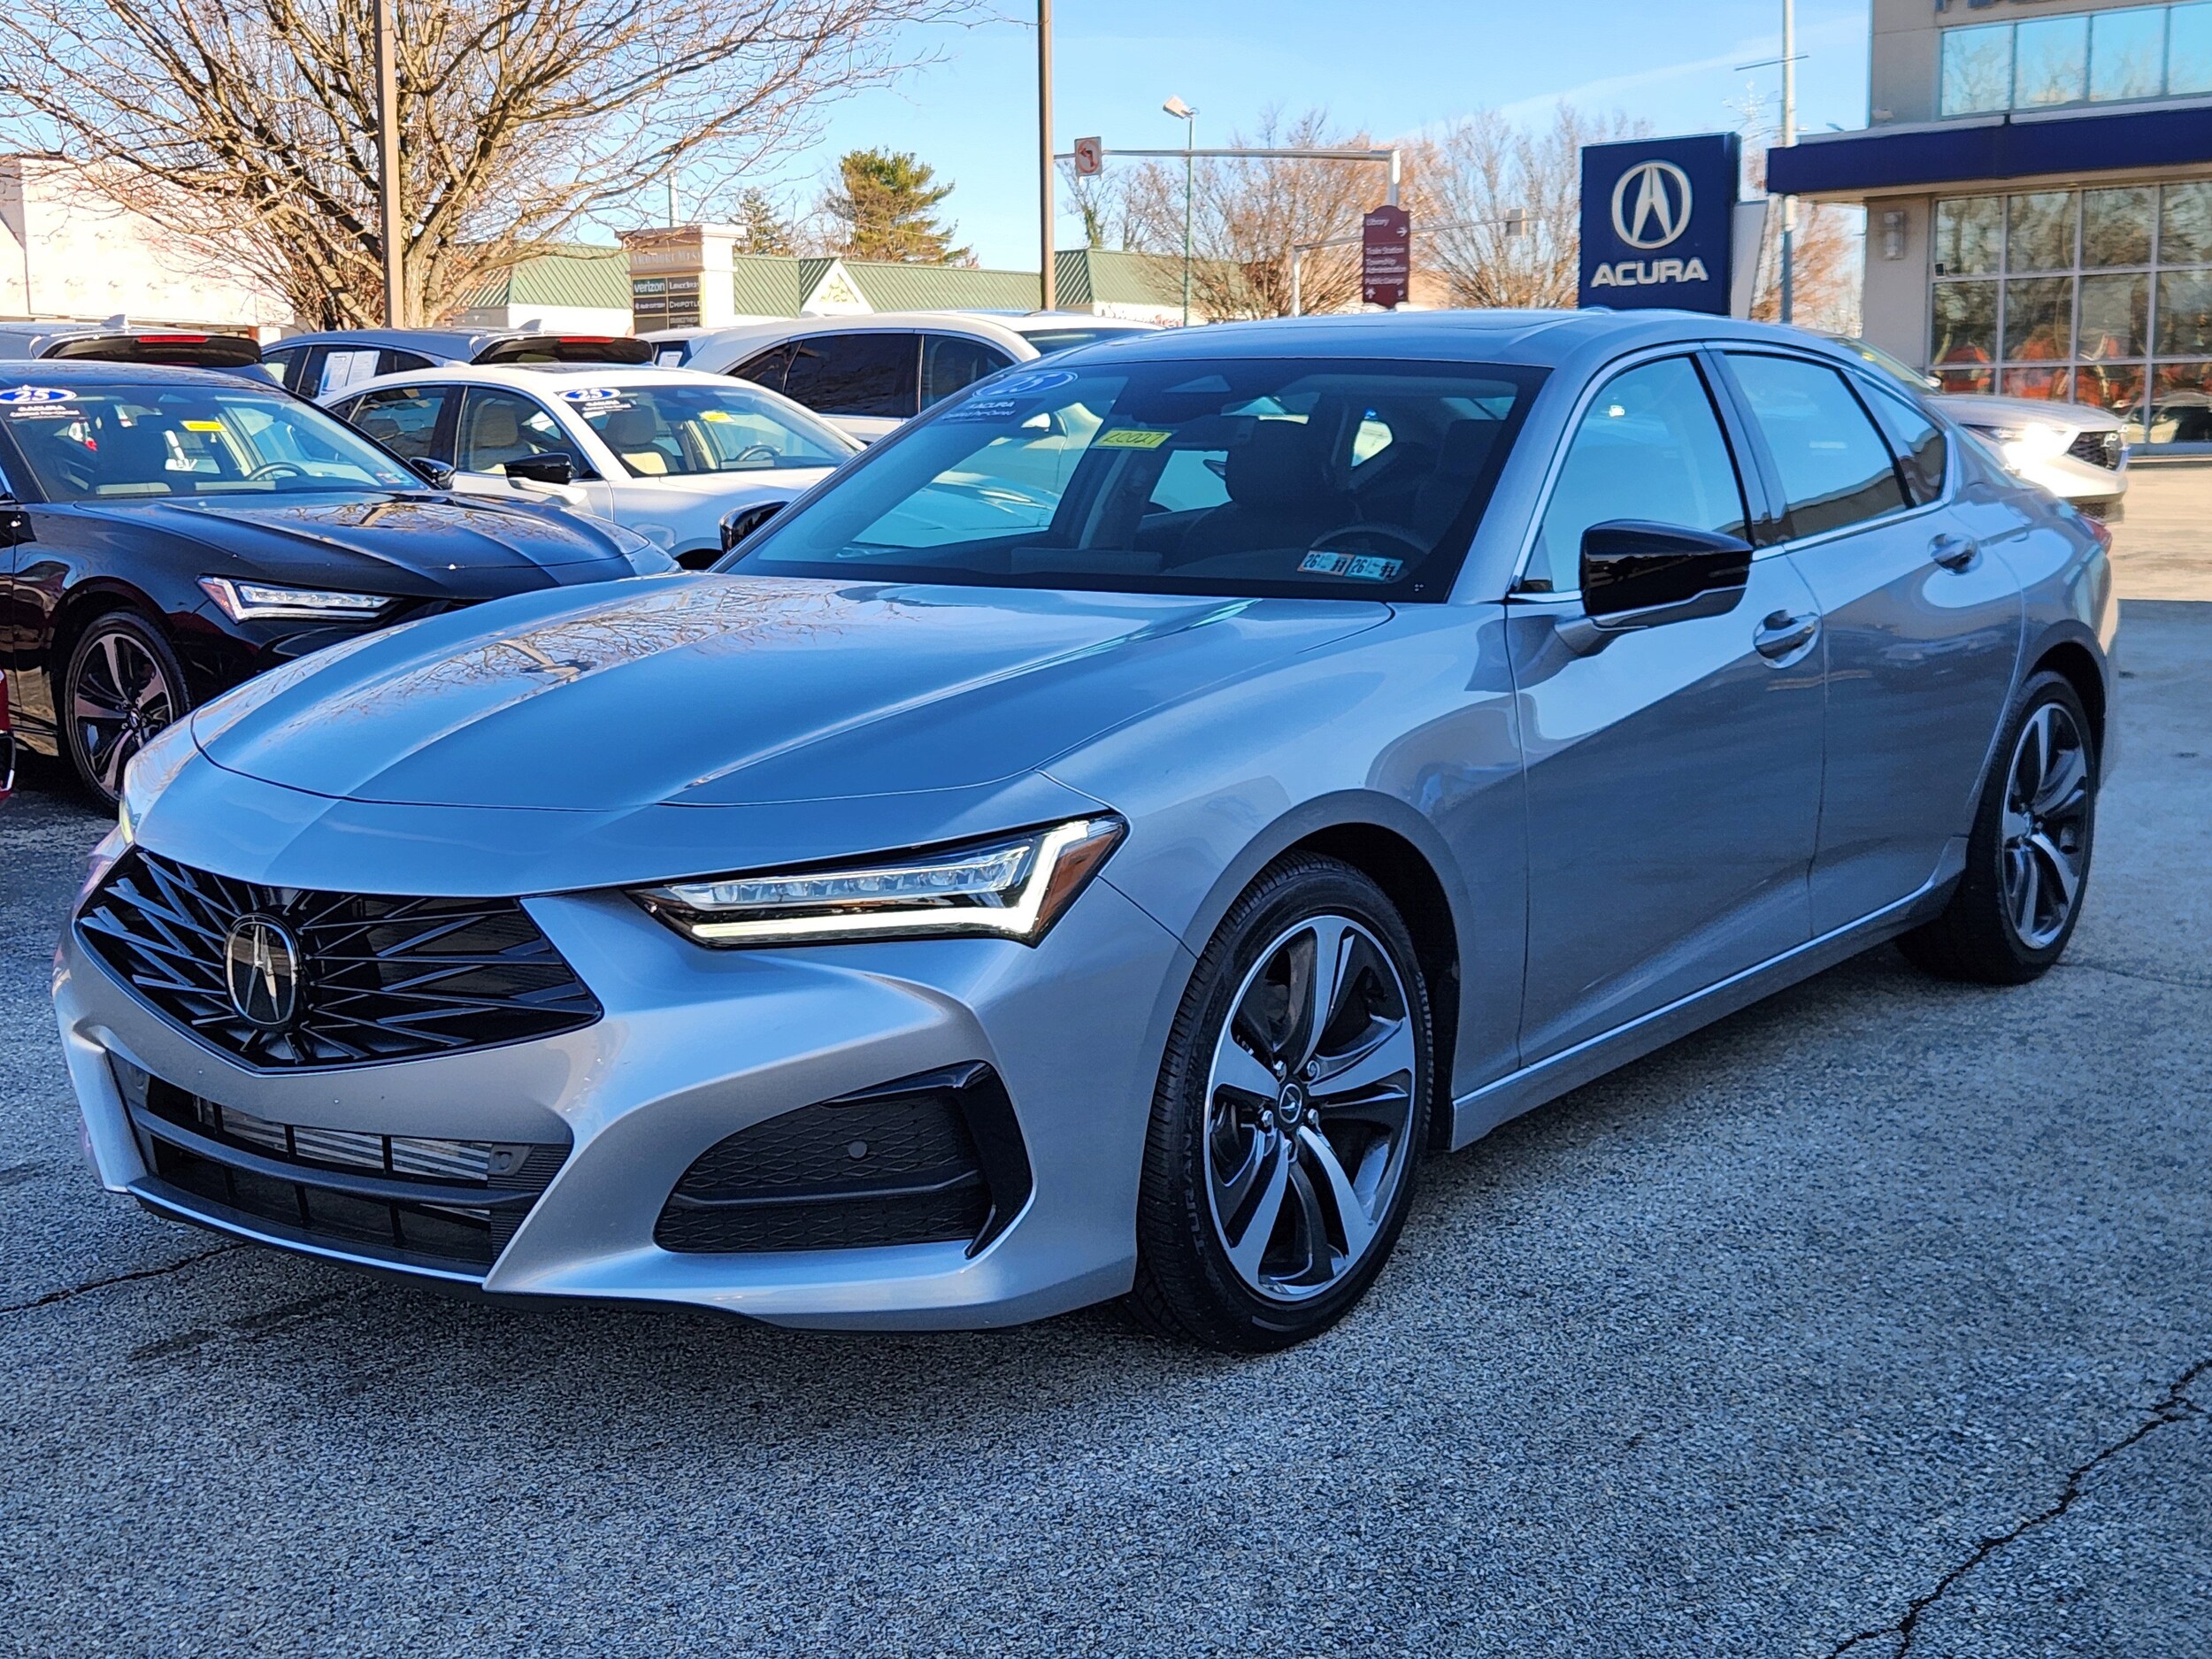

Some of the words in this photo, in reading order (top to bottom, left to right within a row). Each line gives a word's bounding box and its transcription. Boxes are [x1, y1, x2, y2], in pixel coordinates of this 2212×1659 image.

[1590, 258, 1709, 288] ACURA
[634, 280, 665, 293] verizon
[986, 373, 1061, 395] 25
[13, 388, 50, 403] 25
[575, 388, 603, 399] 25
[1303, 554, 1320, 569] 26
[1351, 558, 1368, 573] 26
